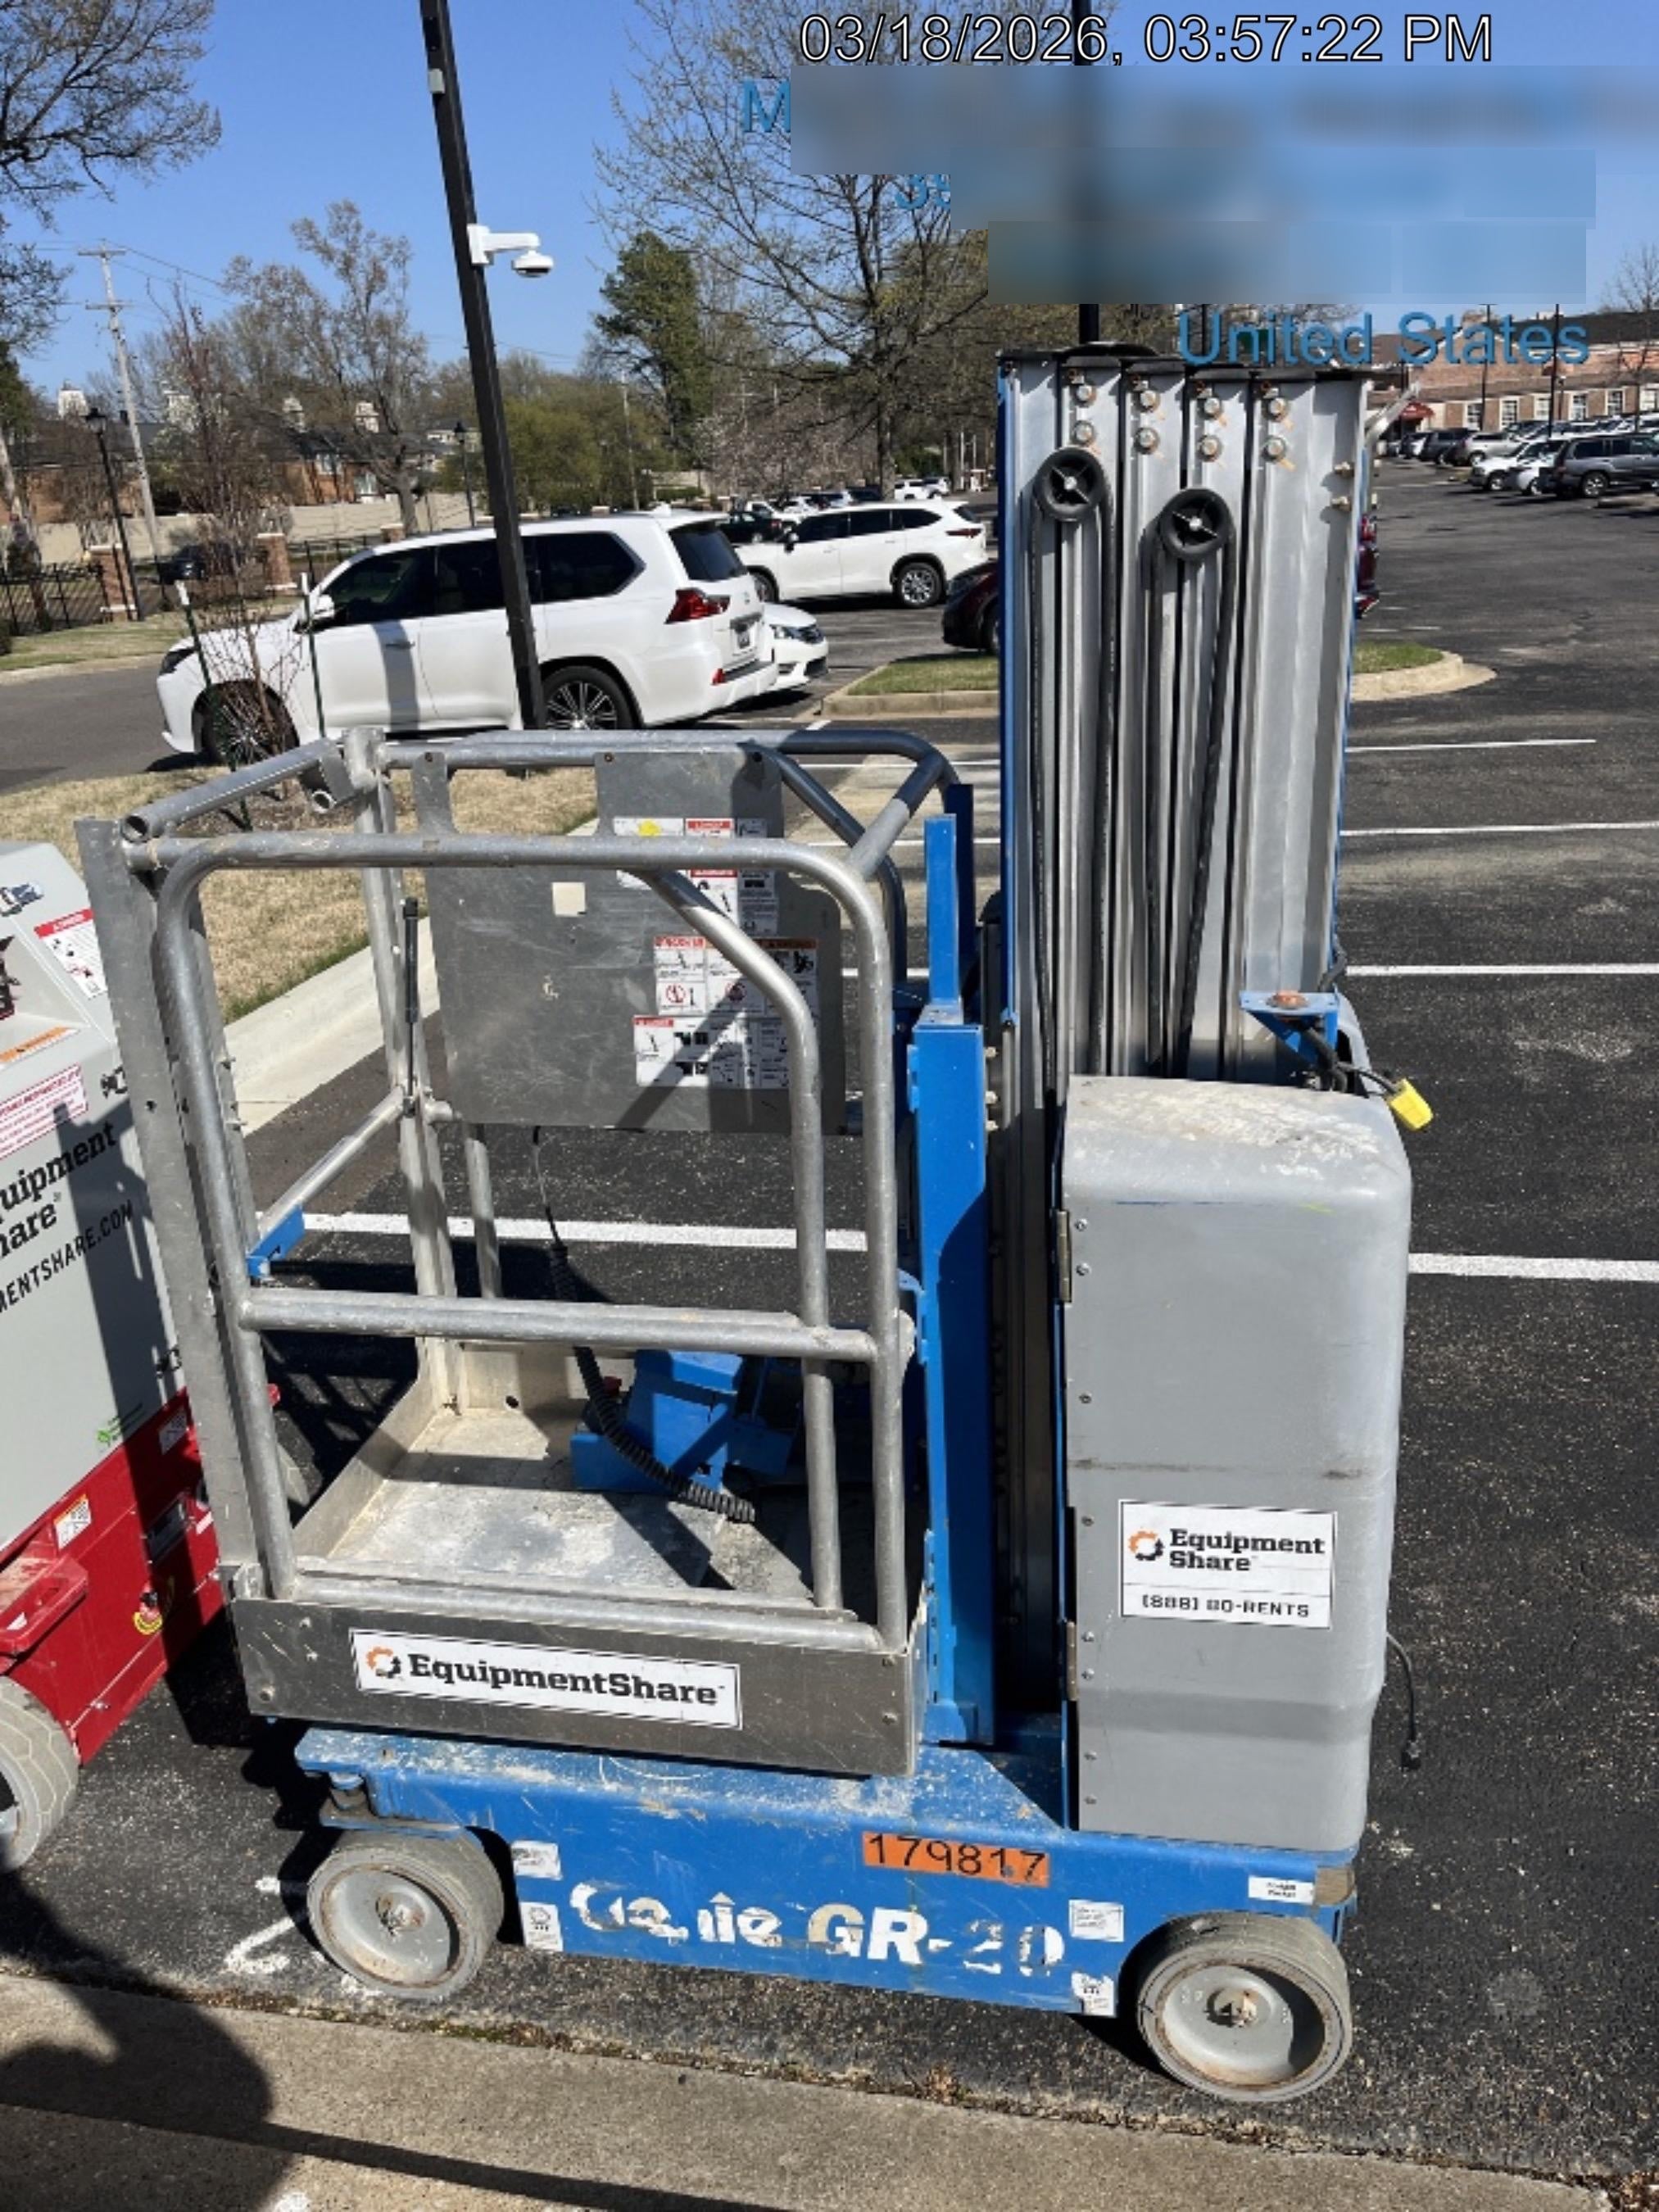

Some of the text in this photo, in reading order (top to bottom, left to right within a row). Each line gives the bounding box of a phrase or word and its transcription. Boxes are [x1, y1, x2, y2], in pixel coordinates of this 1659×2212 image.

[0, 1121, 116, 1217] uipment
[1169, 1550, 1251, 1571] Share
[1170, 1528, 1325, 1554] Equipment
[408, 1652, 717, 1705] EquipmentShare
[868, 1834, 1045, 1882] 179817
